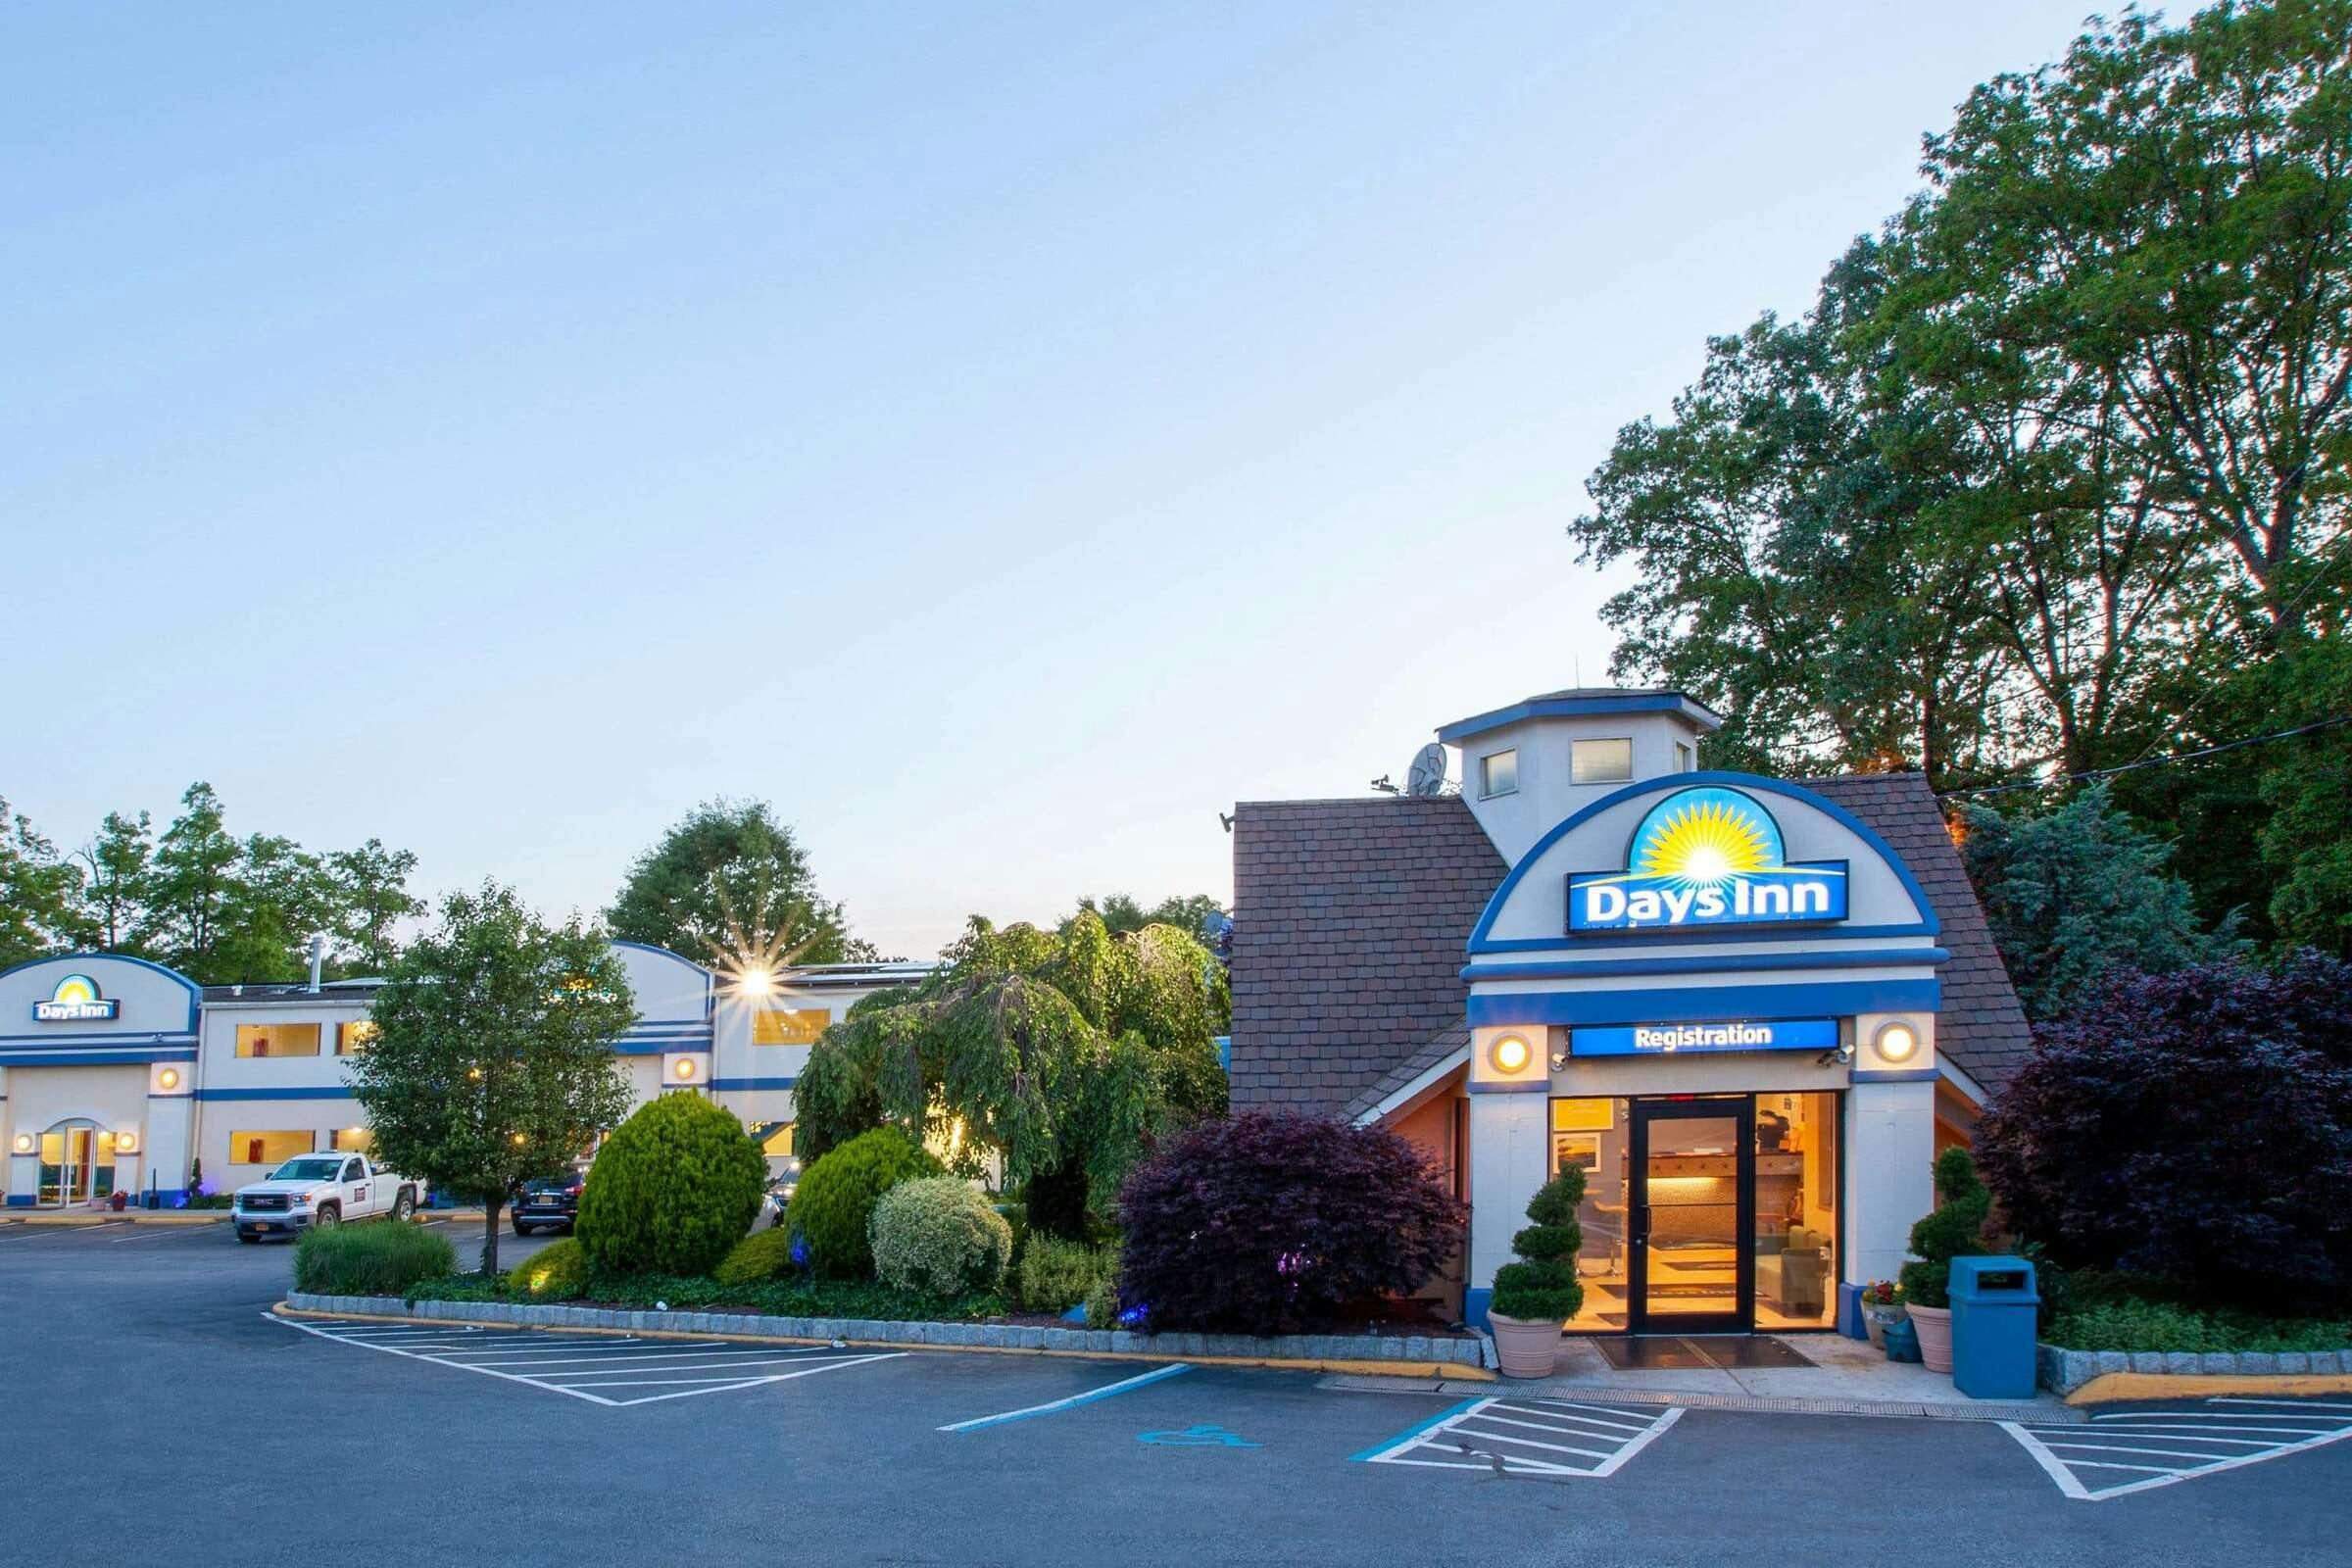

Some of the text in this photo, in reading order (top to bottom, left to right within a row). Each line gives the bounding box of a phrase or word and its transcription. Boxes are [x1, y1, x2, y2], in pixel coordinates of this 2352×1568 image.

[1586, 879, 1830, 923] Days Inn
[37, 1004, 109, 1019] Days Inn
[1635, 1024, 1773, 1052] Registration
